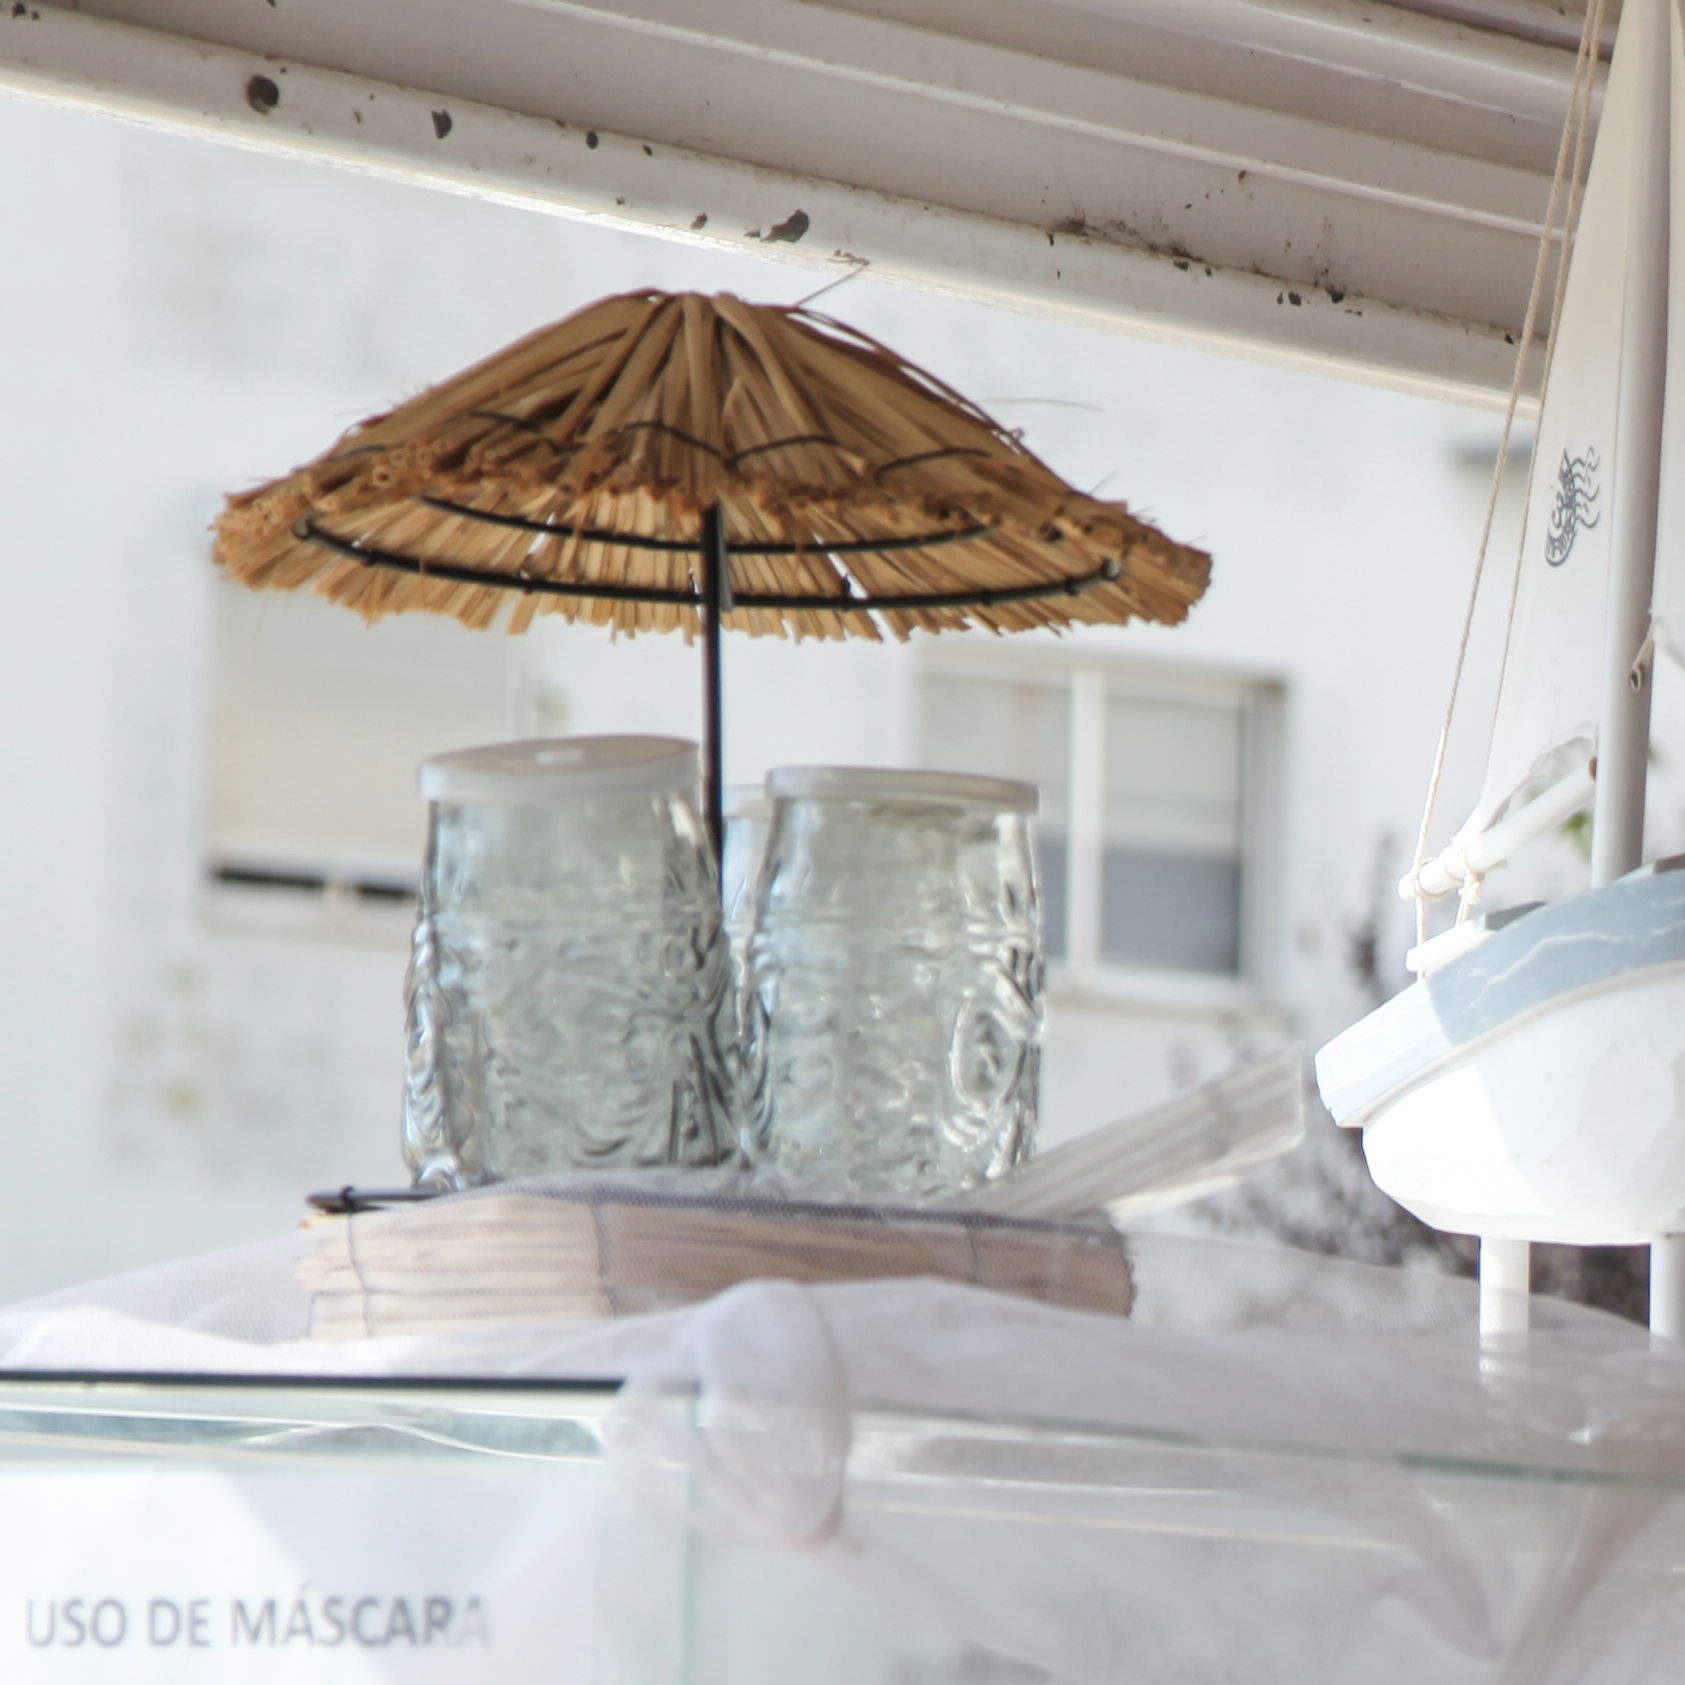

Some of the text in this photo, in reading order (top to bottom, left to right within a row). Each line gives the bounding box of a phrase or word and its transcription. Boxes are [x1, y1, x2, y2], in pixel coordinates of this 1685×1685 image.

[25, 1582, 493, 1648] USO DE MÁSCARA
